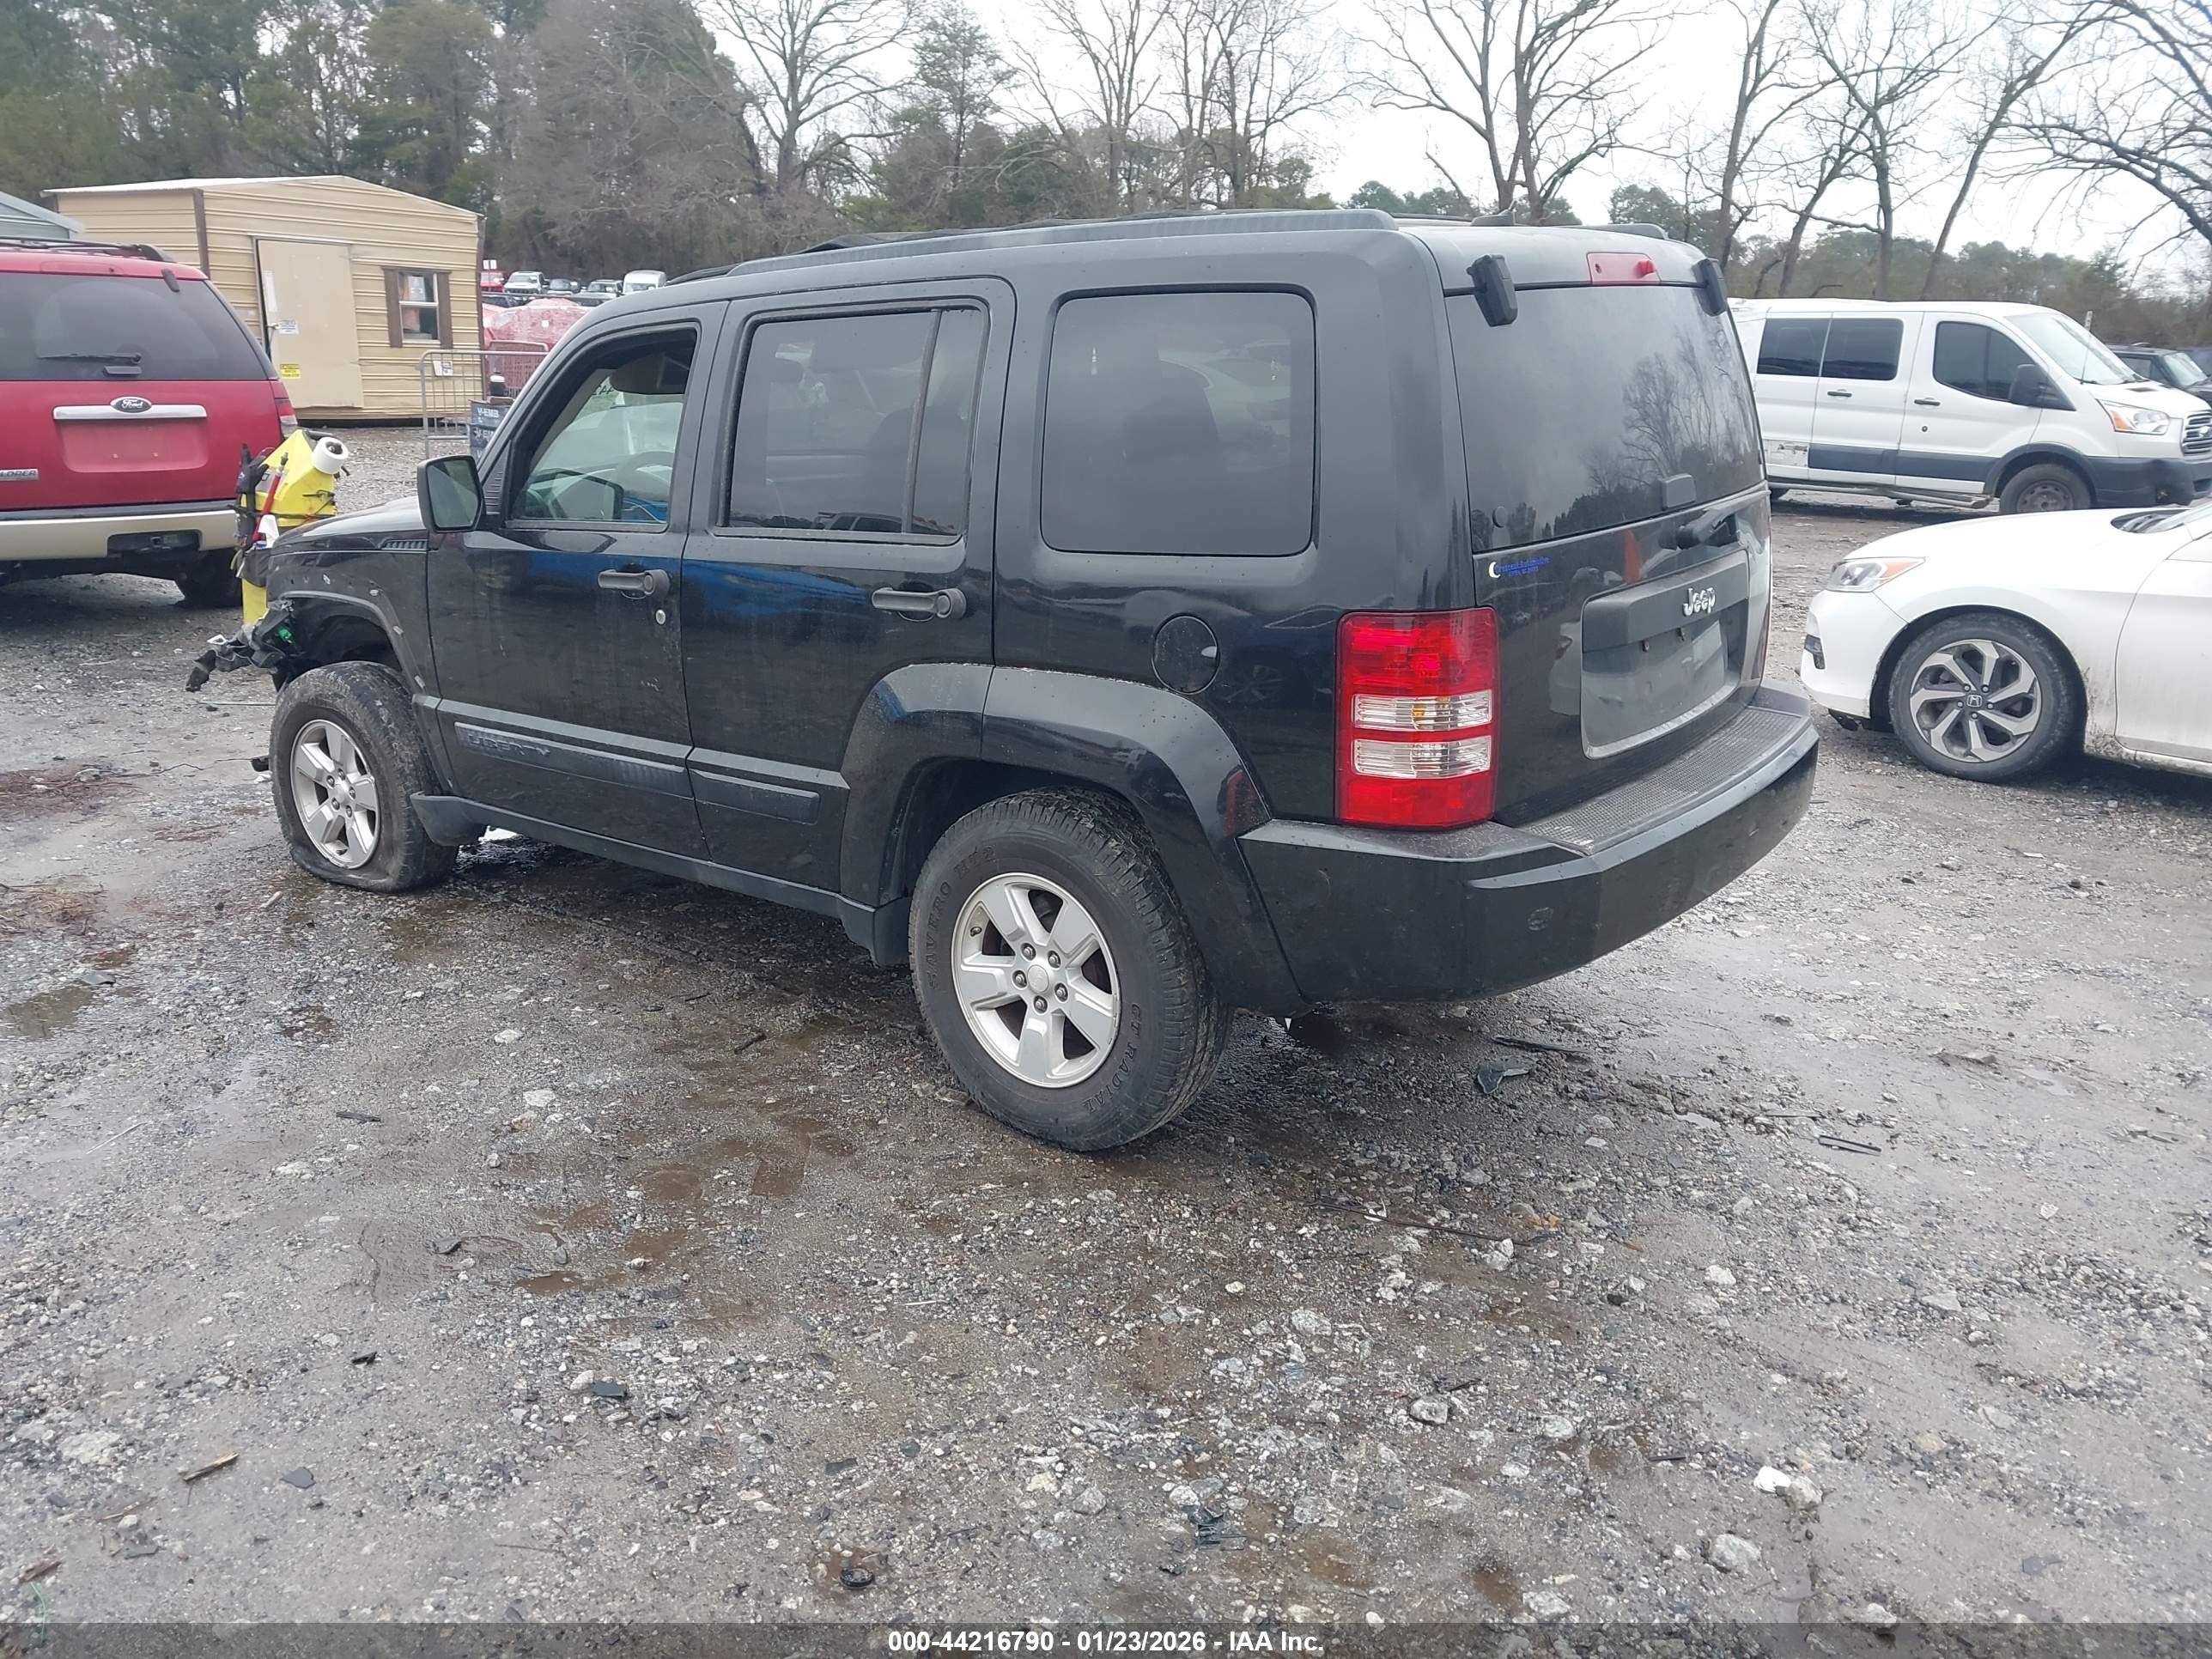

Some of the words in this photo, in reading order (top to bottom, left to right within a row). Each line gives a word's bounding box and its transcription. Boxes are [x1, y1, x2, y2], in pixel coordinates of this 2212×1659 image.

[121, 398, 143, 409] Ford
[1683, 587, 1716, 616] Jeep
[467, 733, 550, 756] LIBERTY
[927, 881, 951, 989] SAVERO
[1082, 1041, 1136, 1113] RADIAL
